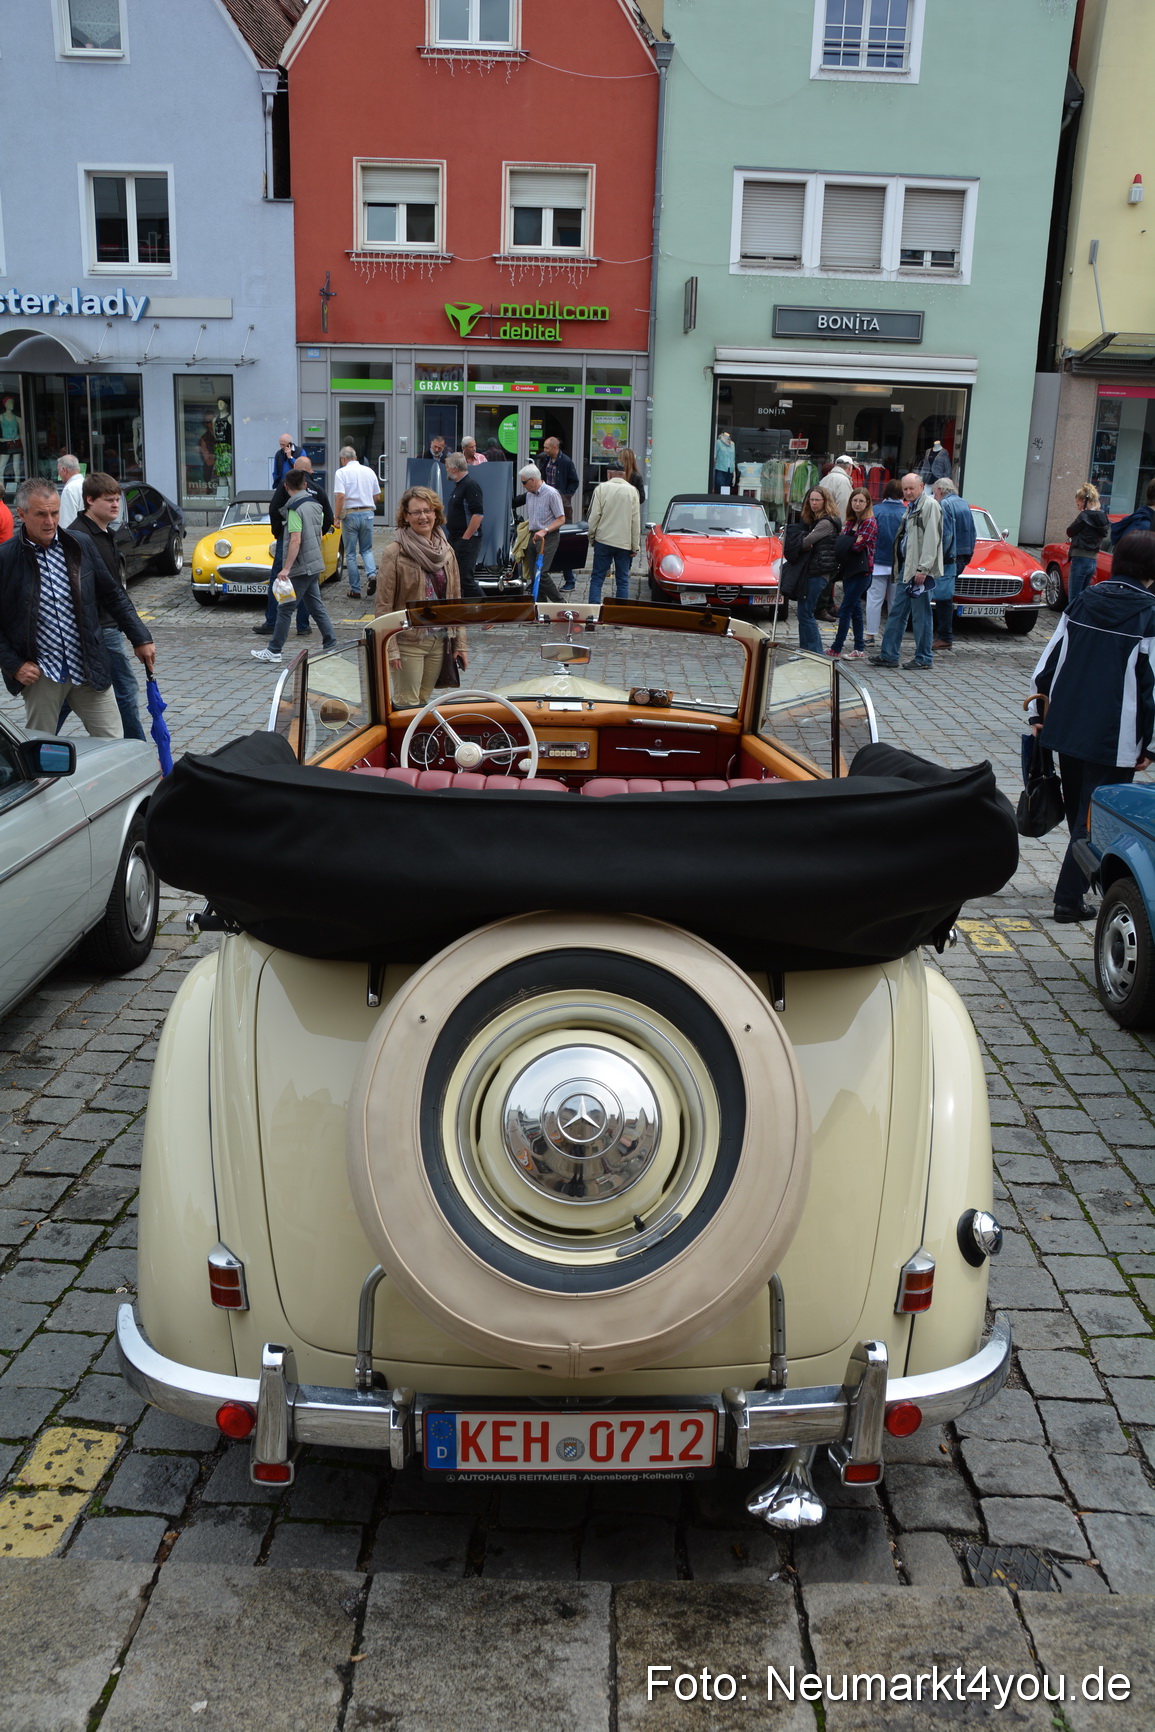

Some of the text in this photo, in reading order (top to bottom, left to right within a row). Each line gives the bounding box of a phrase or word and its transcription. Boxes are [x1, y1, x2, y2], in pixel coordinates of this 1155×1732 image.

[71, 287, 150, 321] lady
[500, 300, 610, 320] mobilcom
[500, 322, 562, 341] debitel
[419, 381, 459, 391] GRAVIS
[227, 584, 243, 593] LAU
[962, 606, 974, 615] ED
[436, 1446, 448, 1458] D
[460, 1420, 550, 1463] KEH
[589, 1418, 704, 1463] 0712
[583, 1473, 683, 1482] Abensberg-Kelheim
